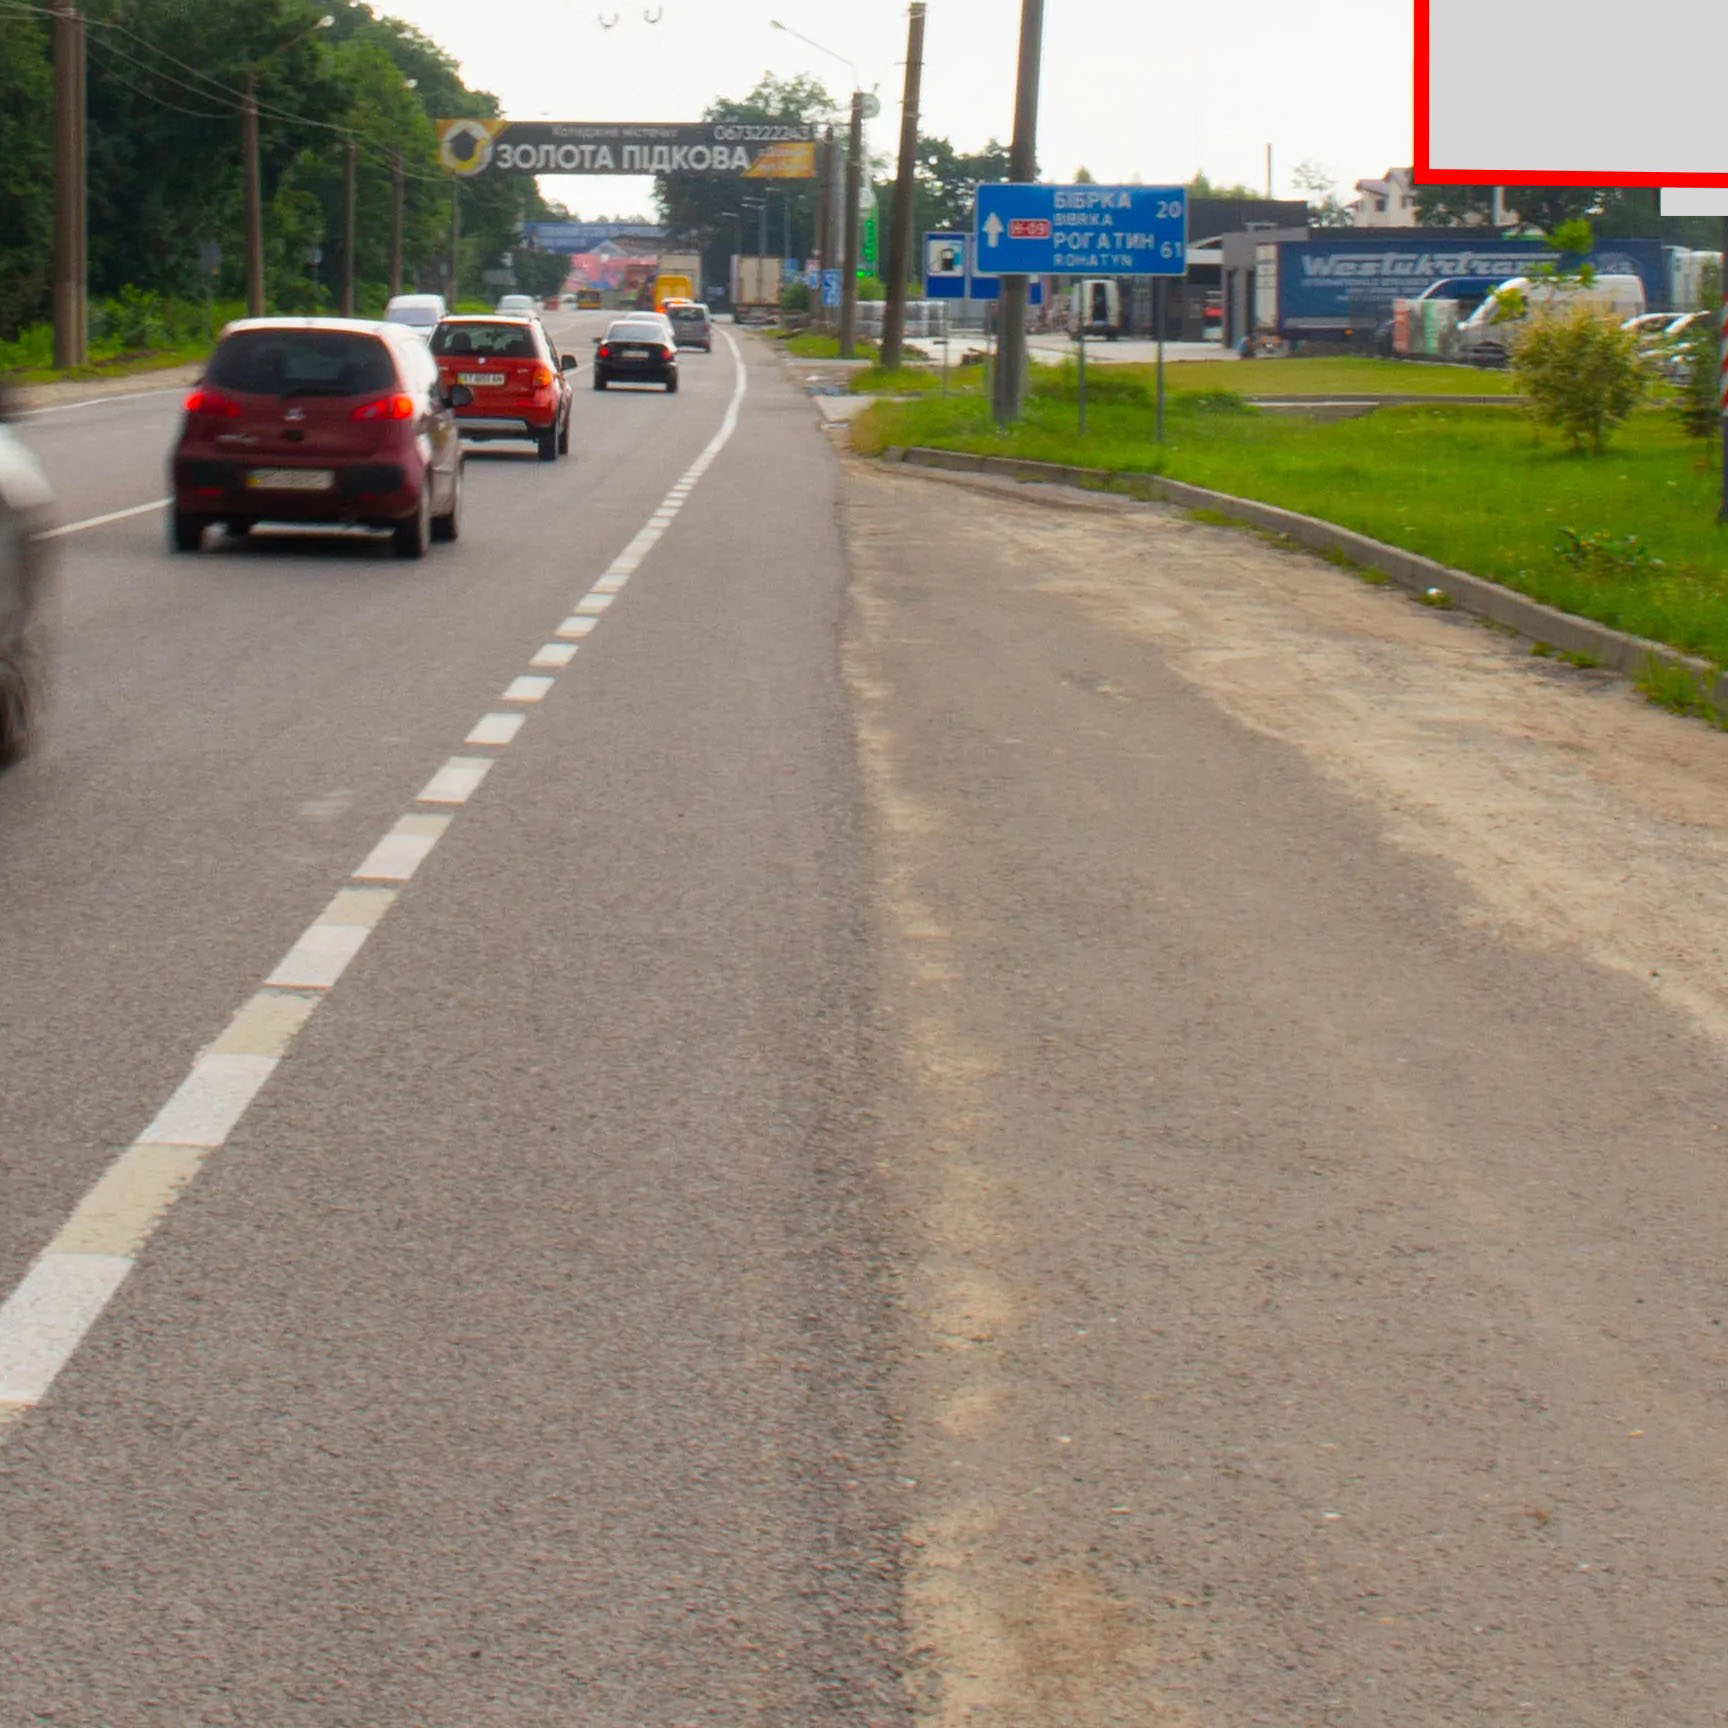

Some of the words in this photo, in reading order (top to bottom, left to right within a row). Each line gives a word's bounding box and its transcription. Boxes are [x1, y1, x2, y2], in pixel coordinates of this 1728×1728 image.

[496, 144, 615, 170] ЗОЛОТА
[623, 145, 751, 173] ПІДКОВА
[1053, 191, 1132, 210] БІБРКА
[1156, 201, 1183, 219] 20
[1053, 232, 1155, 250] РОГАТИН
[1160, 241, 1183, 259] 61
[1053, 254, 1134, 268] ROHATYN
